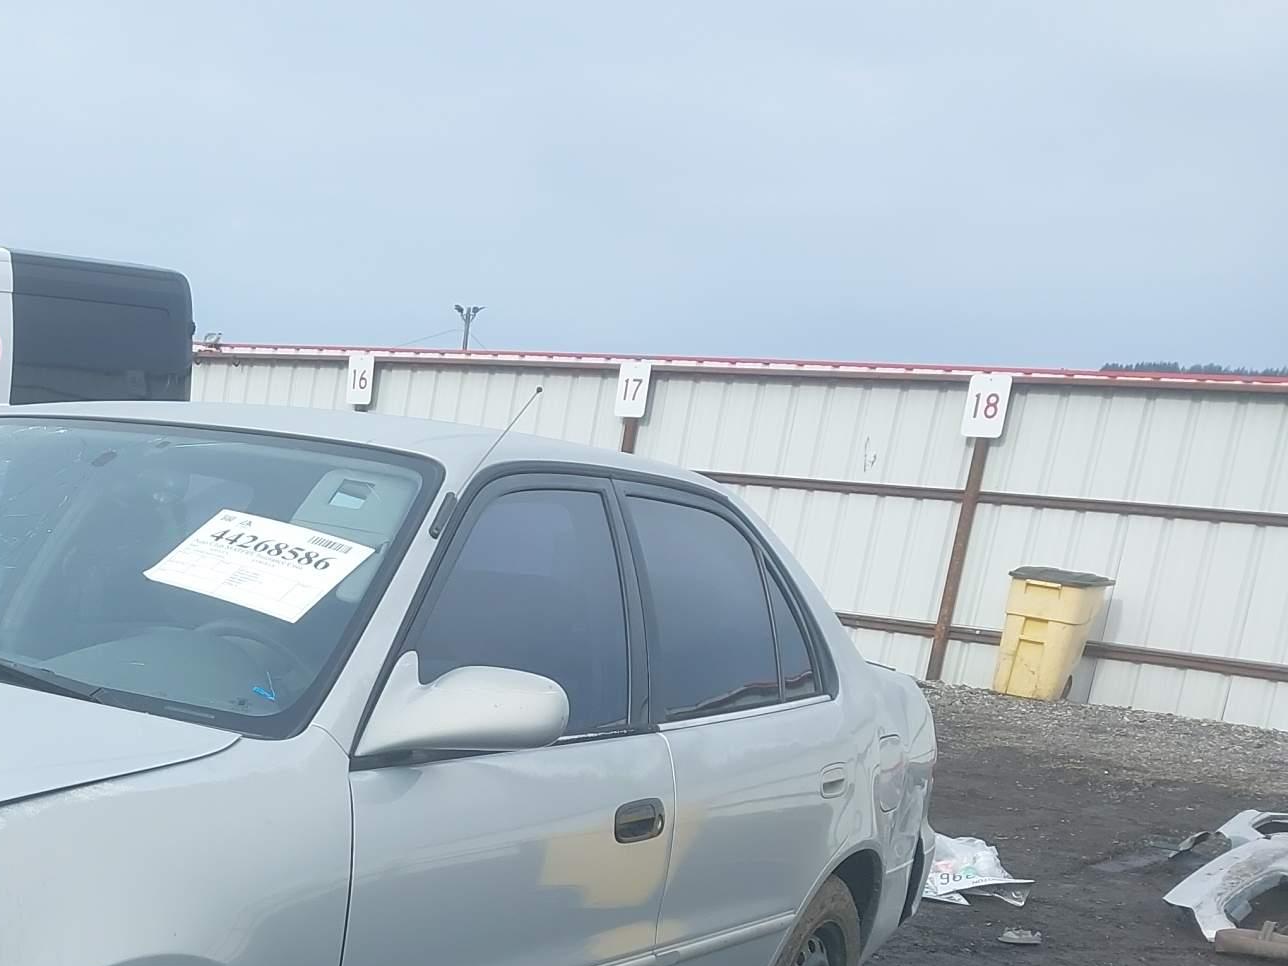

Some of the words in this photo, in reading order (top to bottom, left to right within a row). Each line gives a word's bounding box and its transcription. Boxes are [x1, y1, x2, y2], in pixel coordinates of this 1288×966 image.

[352, 369, 368, 390] 16
[623, 378, 643, 401] 17
[972, 392, 1000, 419] 18
[210, 529, 337, 571] 44268586
